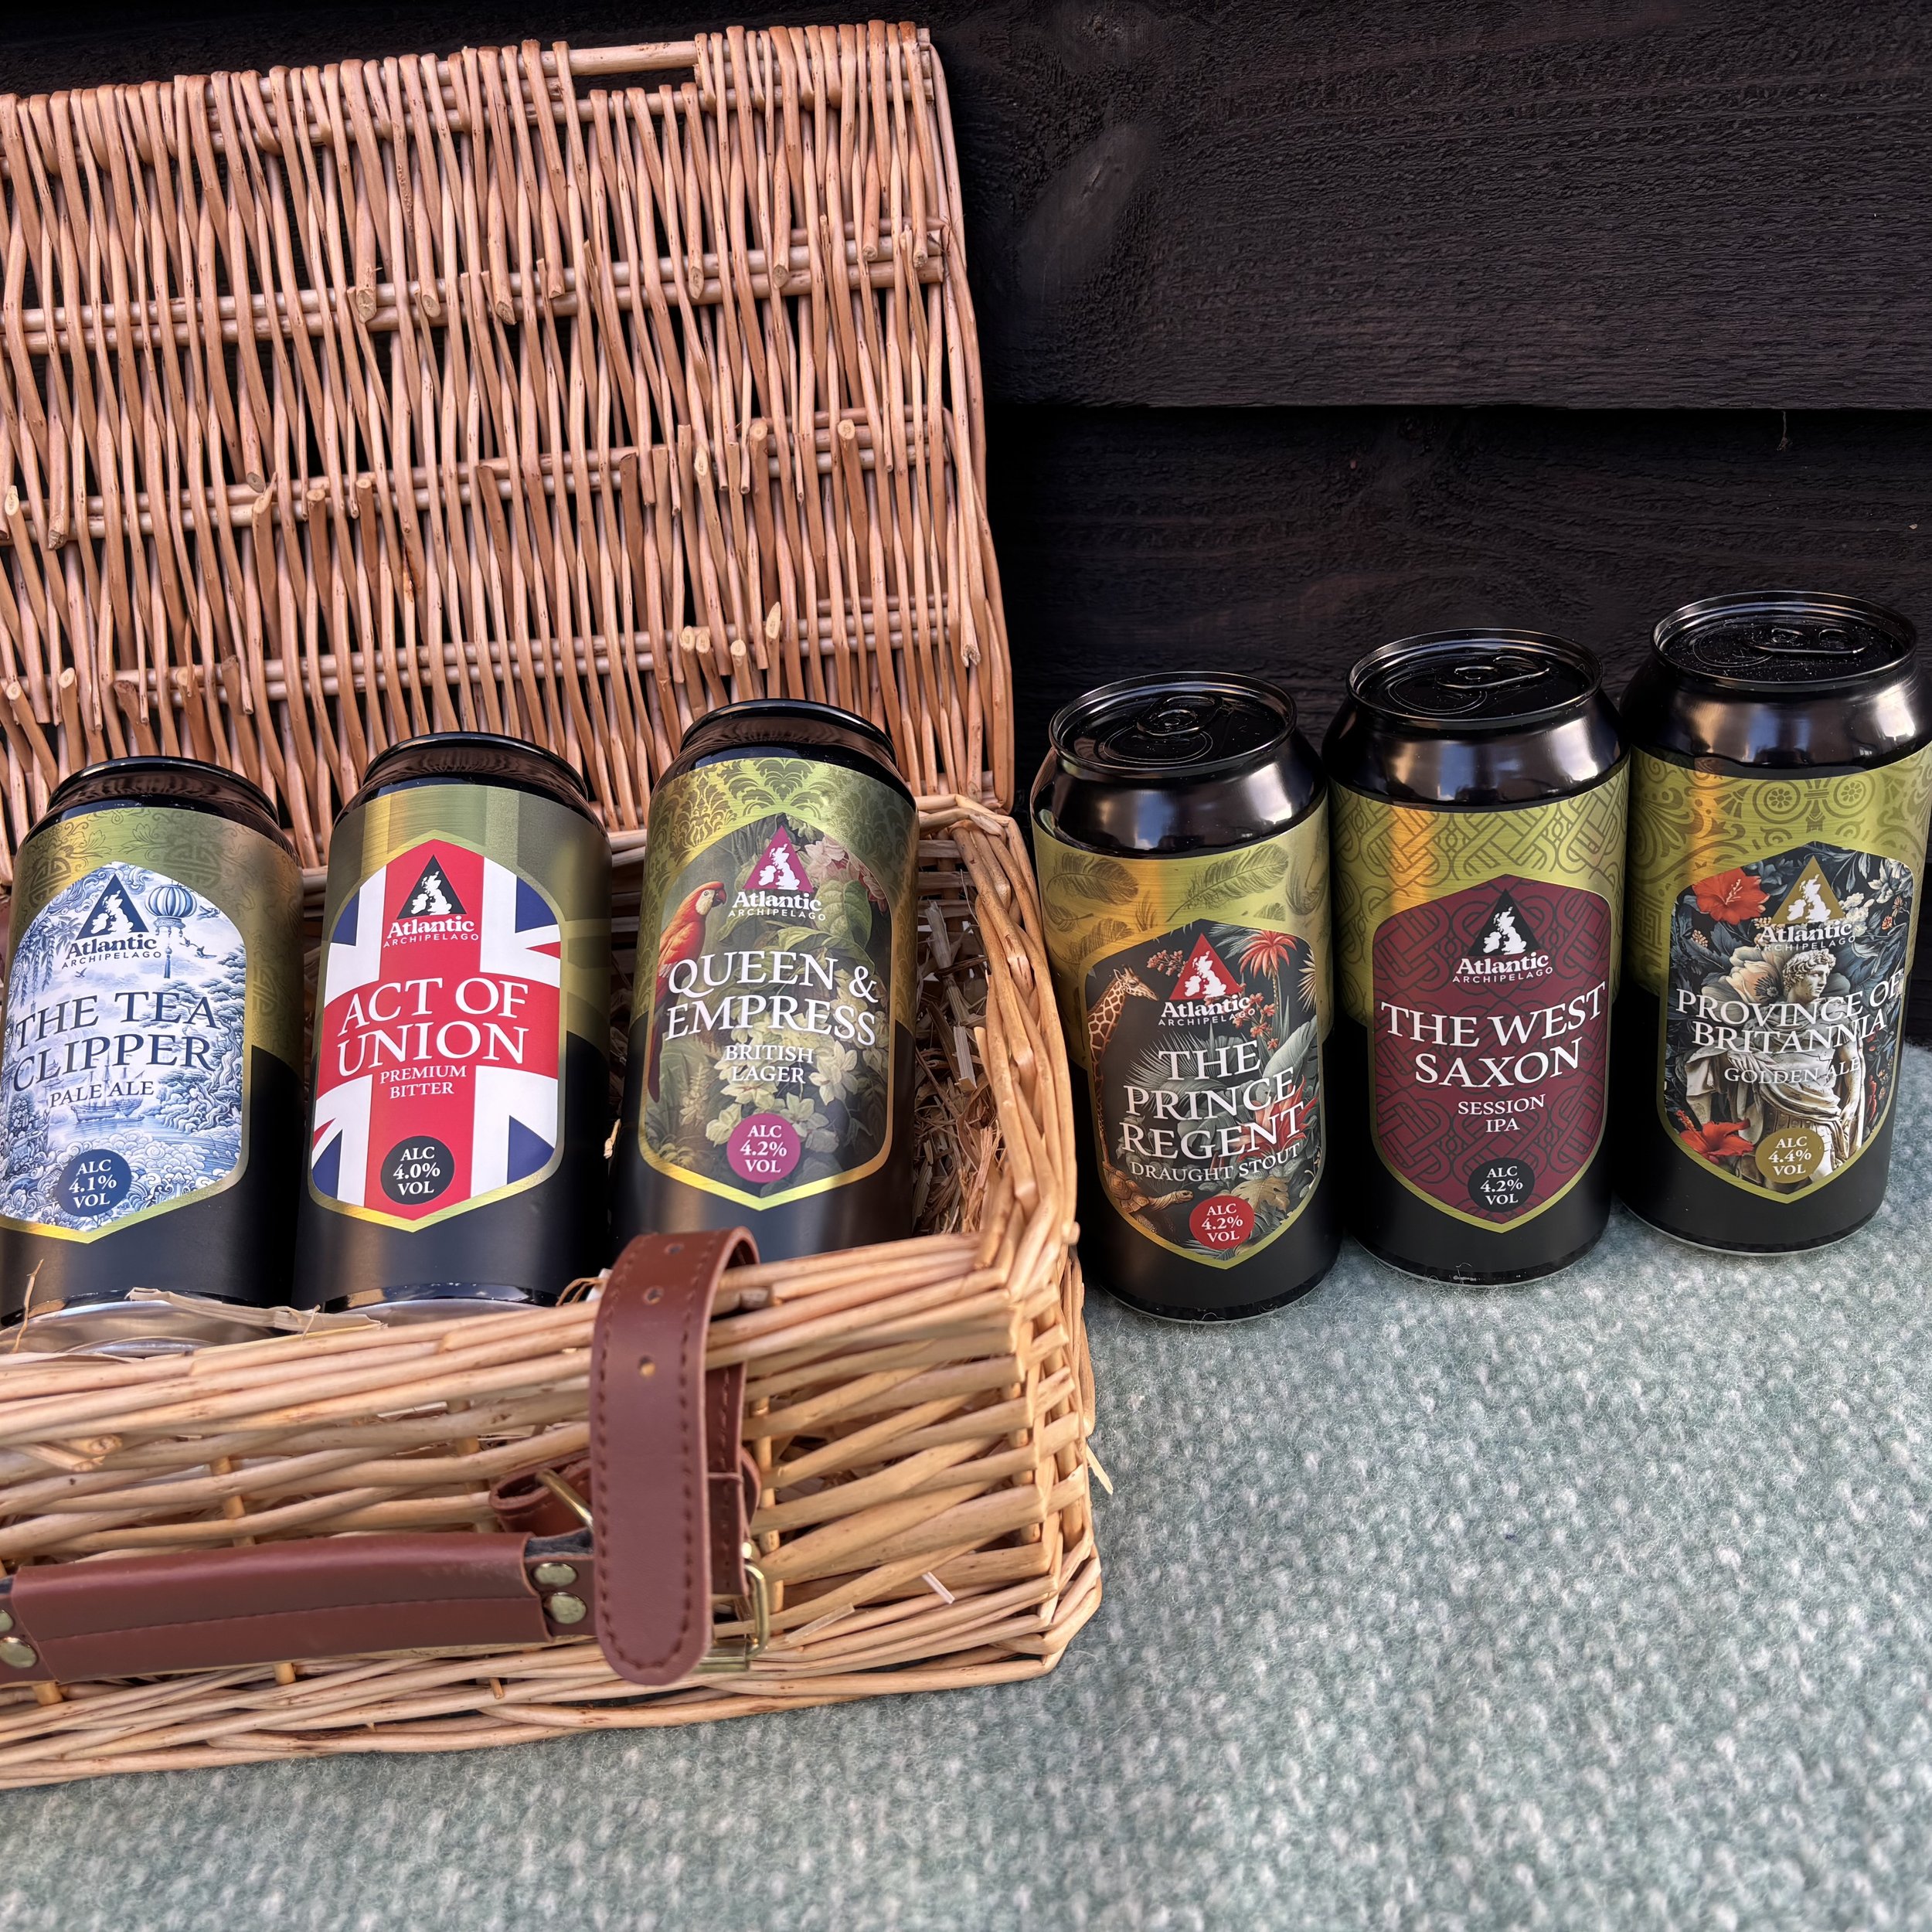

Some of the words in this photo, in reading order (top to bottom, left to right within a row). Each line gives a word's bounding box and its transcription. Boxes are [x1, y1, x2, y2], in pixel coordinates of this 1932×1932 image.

[733, 890, 822, 911] Atlantic
[729, 909, 826, 921] ARCHIPELAGO
[387, 916, 475, 939] Atlantic
[1759, 920, 1852, 943] Atlantic
[66, 934, 157, 961] Atlantic
[383, 934, 479, 948] ARCHIPELAGO
[1754, 934, 1856, 952] ARCHIPELAGO
[61, 950, 162, 969] ARCHIPELAGO
[1456, 952, 1549, 975] Atlantic
[668, 951, 838, 999] QUEEN
[849, 965, 879, 1003] &
[1452, 967, 1553, 983] ARCHIPELAGO
[337, 978, 443, 1037] ACT
[454, 978, 529, 1019] OF
[1161, 995, 1250, 1019] Atlantic
[1675, 988, 1866, 1029] PROVINCE
[1869, 968, 1903, 1010] OF
[15, 995, 98, 1052] THE
[115, 991, 221, 1030] TEA
[665, 995, 876, 1046] EMPRESS
[1158, 1009, 1256, 1027] ARCHIPELAGO
[1380, 1002, 1480, 1048] THE
[1488, 981, 1606, 1046] WEST
[1692, 1009, 1887, 1055] BRITANNIA
[337, 1020, 529, 1077] UNION
[723, 1045, 814, 1063] BRITISH
[13, 1033, 216, 1092] CLIPPER
[1158, 1039, 1261, 1080] THE
[1414, 1036, 1583, 1088] SAXON
[379, 1065, 467, 1083] PREMIUM
[730, 1066, 806, 1083] LAGER
[1724, 1066, 1820, 1084] GOLDEN
[1825, 1058, 1860, 1077] ALE
[49, 1083, 100, 1109] PALE
[107, 1080, 155, 1097] ALE
[389, 1081, 454, 1099] BITTER
[1123, 1066, 1297, 1121] PRINCE
[1458, 1094, 1546, 1115] SESSION
[747, 1124, 782, 1138] ALC
[1120, 1103, 1304, 1159] REGENT
[1485, 1118, 1520, 1133] IPA
[740, 1141, 787, 1157] 4.2%
[1775, 1135, 1808, 1150] ALC
[400, 1146, 435, 1162] ALC
[1130, 1162, 1233, 1182] DRAUGHT
[1238, 1142, 1301, 1177] STOUT
[1768, 1148, 1811, 1164] 4.4%
[76, 1159, 112, 1175] ALC
[393, 1163, 440, 1180] 4.0%
[745, 1158, 781, 1173] VOL
[1486, 1165, 1519, 1179] ALC
[1774, 1164, 1806, 1176] VOL
[68, 1175, 117, 1192] 4.1%
[398, 1180, 434, 1196] VOL
[1480, 1178, 1523, 1193] 4.2%
[73, 1193, 111, 1209] VOL
[1485, 1193, 1519, 1205] VOL
[1206, 1202, 1237, 1217] ALC
[1201, 1216, 1243, 1231] 4.2%
[1207, 1229, 1240, 1242] VOL
